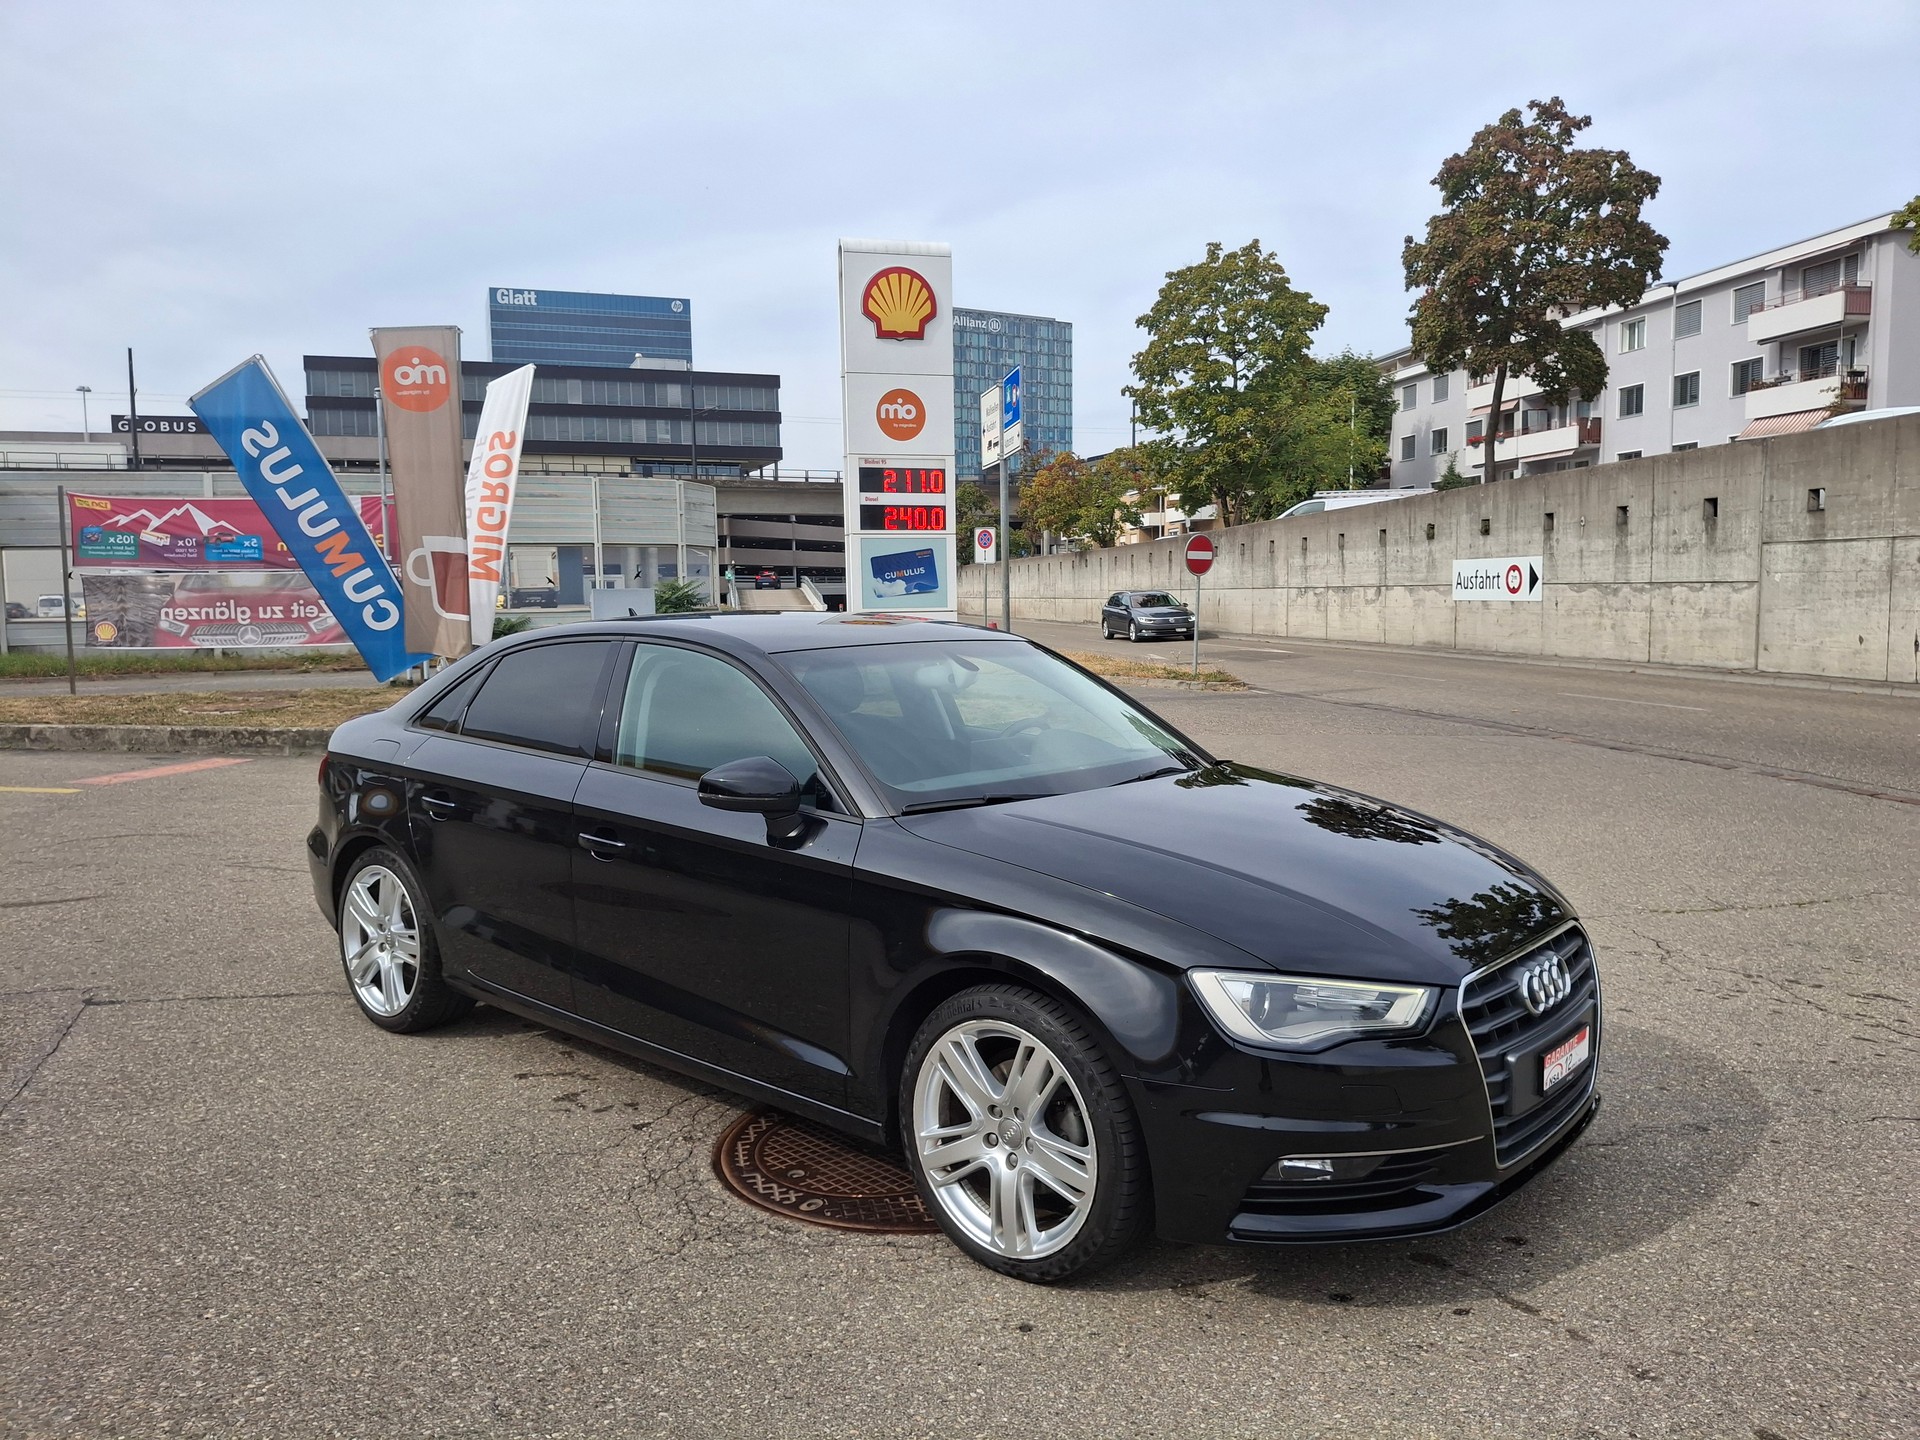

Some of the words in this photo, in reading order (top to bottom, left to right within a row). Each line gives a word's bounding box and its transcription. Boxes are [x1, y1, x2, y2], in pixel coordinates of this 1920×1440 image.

[496, 288, 537, 306] Glatt
[672, 302, 682, 312] hp
[953, 315, 987, 329] Allianz
[880, 397, 917, 420] mio
[883, 469, 943, 493] 211.0
[884, 507, 944, 530] 240.0
[885, 566, 926, 580] CUMULUS
[1455, 569, 1501, 590] Ausfahrt
